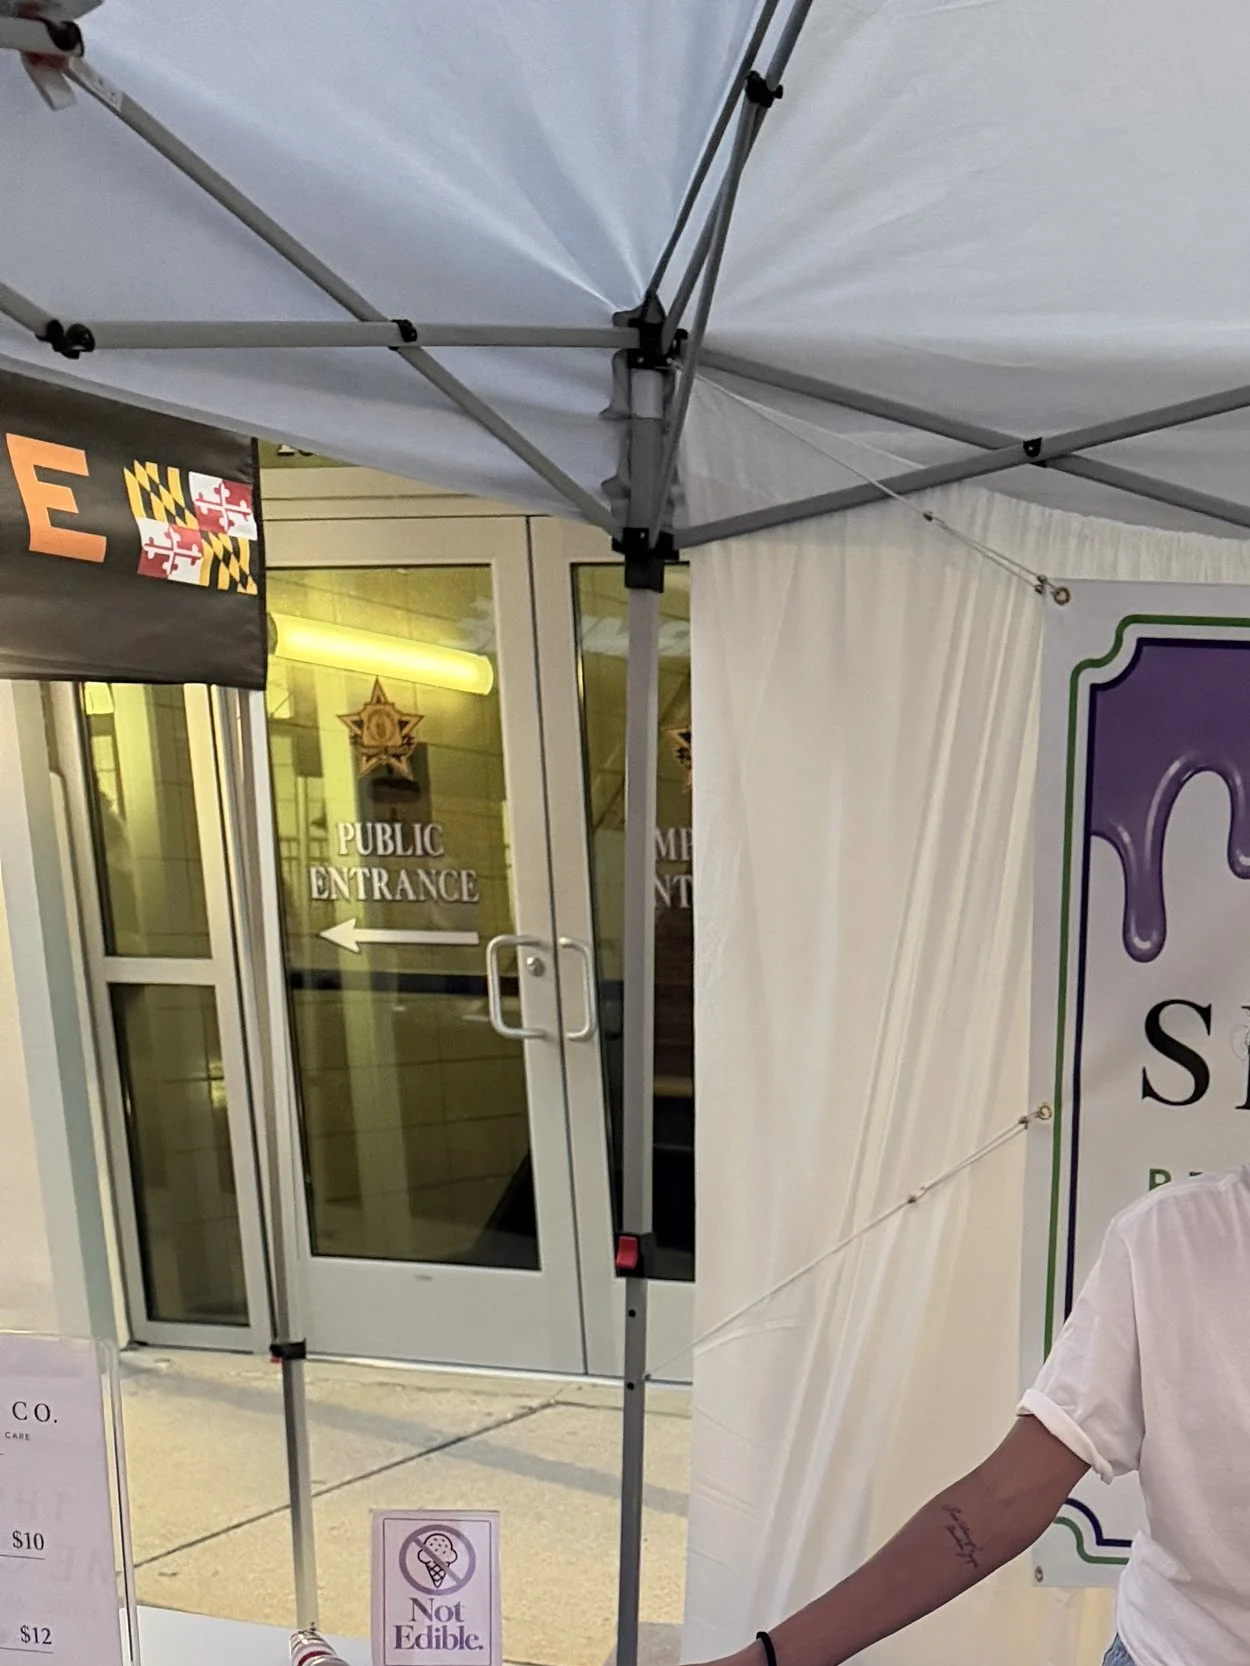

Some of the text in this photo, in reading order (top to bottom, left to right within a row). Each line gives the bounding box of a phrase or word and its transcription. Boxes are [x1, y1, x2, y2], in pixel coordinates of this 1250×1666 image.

[337, 821, 444, 858] PUBLIC
[310, 866, 479, 903] ENTRANCE
[12, 1401, 58, 1424] CO.
[12, 1530, 45, 1551] $10
[408, 1597, 465, 1622] Not
[20, 1625, 52, 1645] $12
[393, 1624, 484, 1650] Edible.
